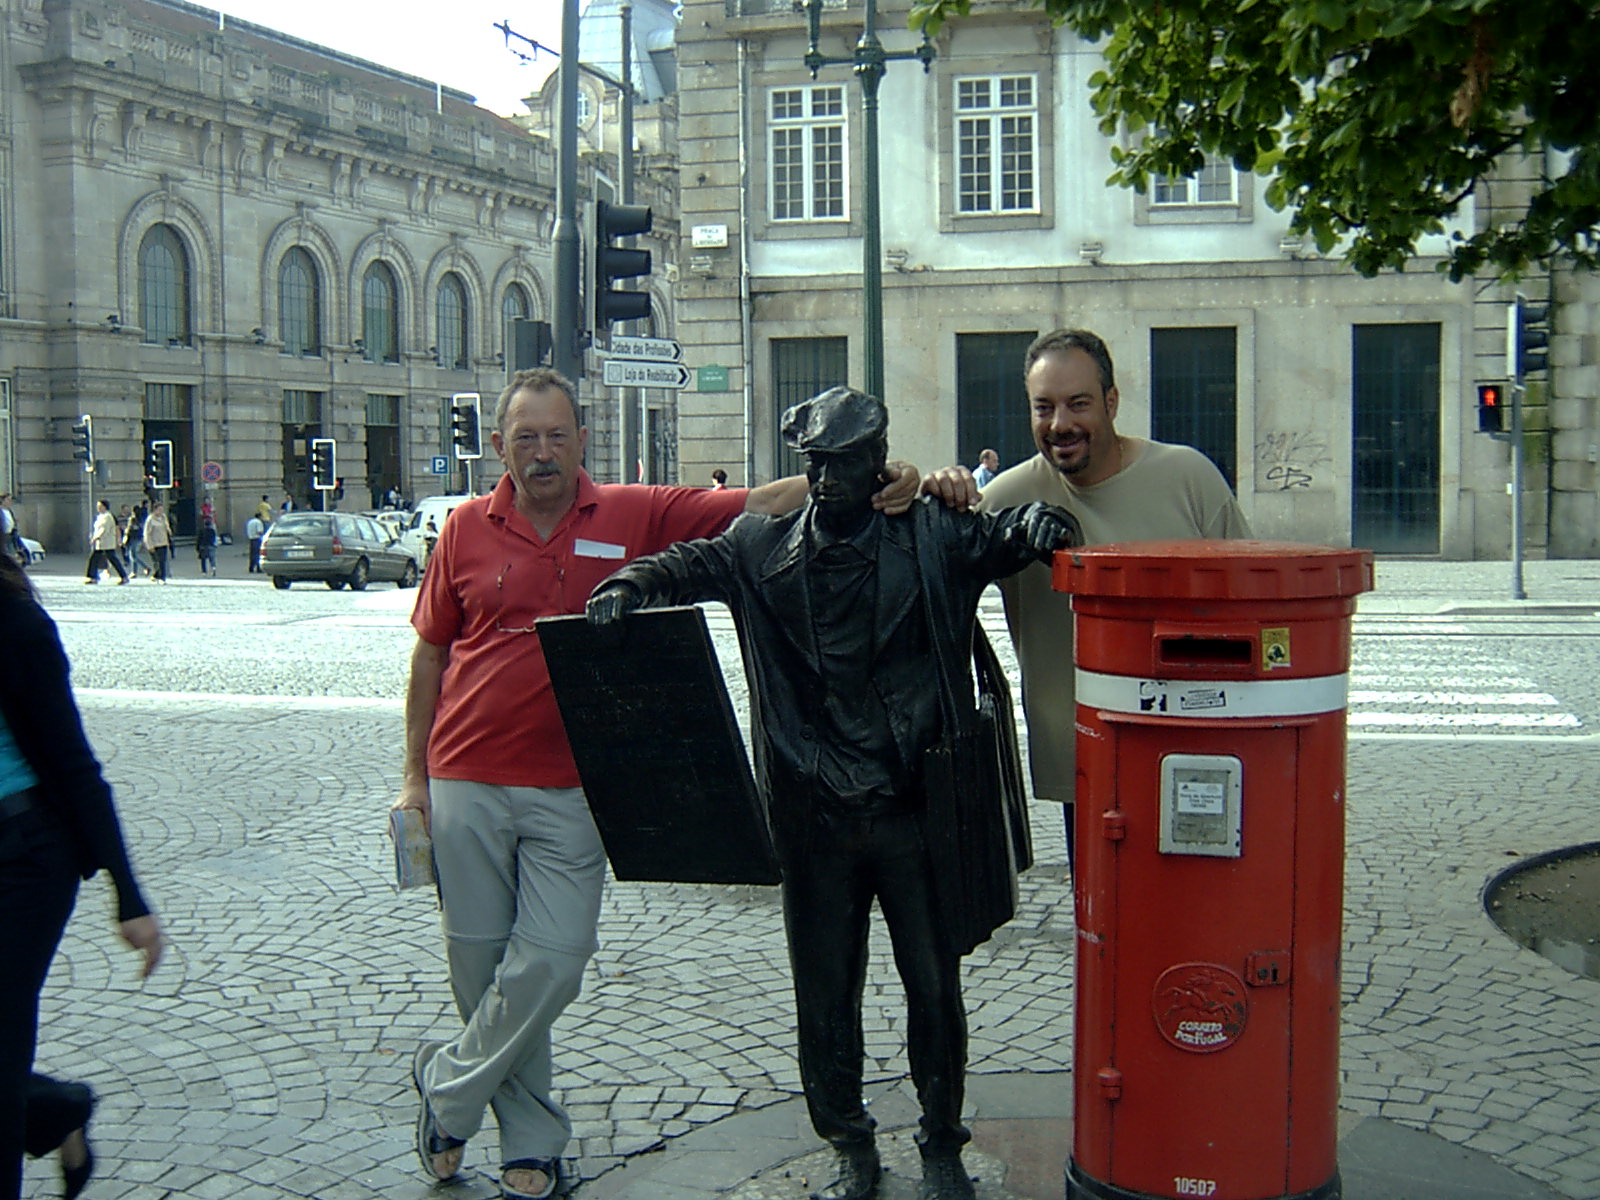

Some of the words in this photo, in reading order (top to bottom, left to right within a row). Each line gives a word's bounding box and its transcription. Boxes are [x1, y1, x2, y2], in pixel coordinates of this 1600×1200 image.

[625, 367, 637, 383] Loja
[435, 459, 446, 472] P
[1174, 1030, 1228, 1046] PORTUGAL
[1173, 1176, 1216, 1196] 10507
